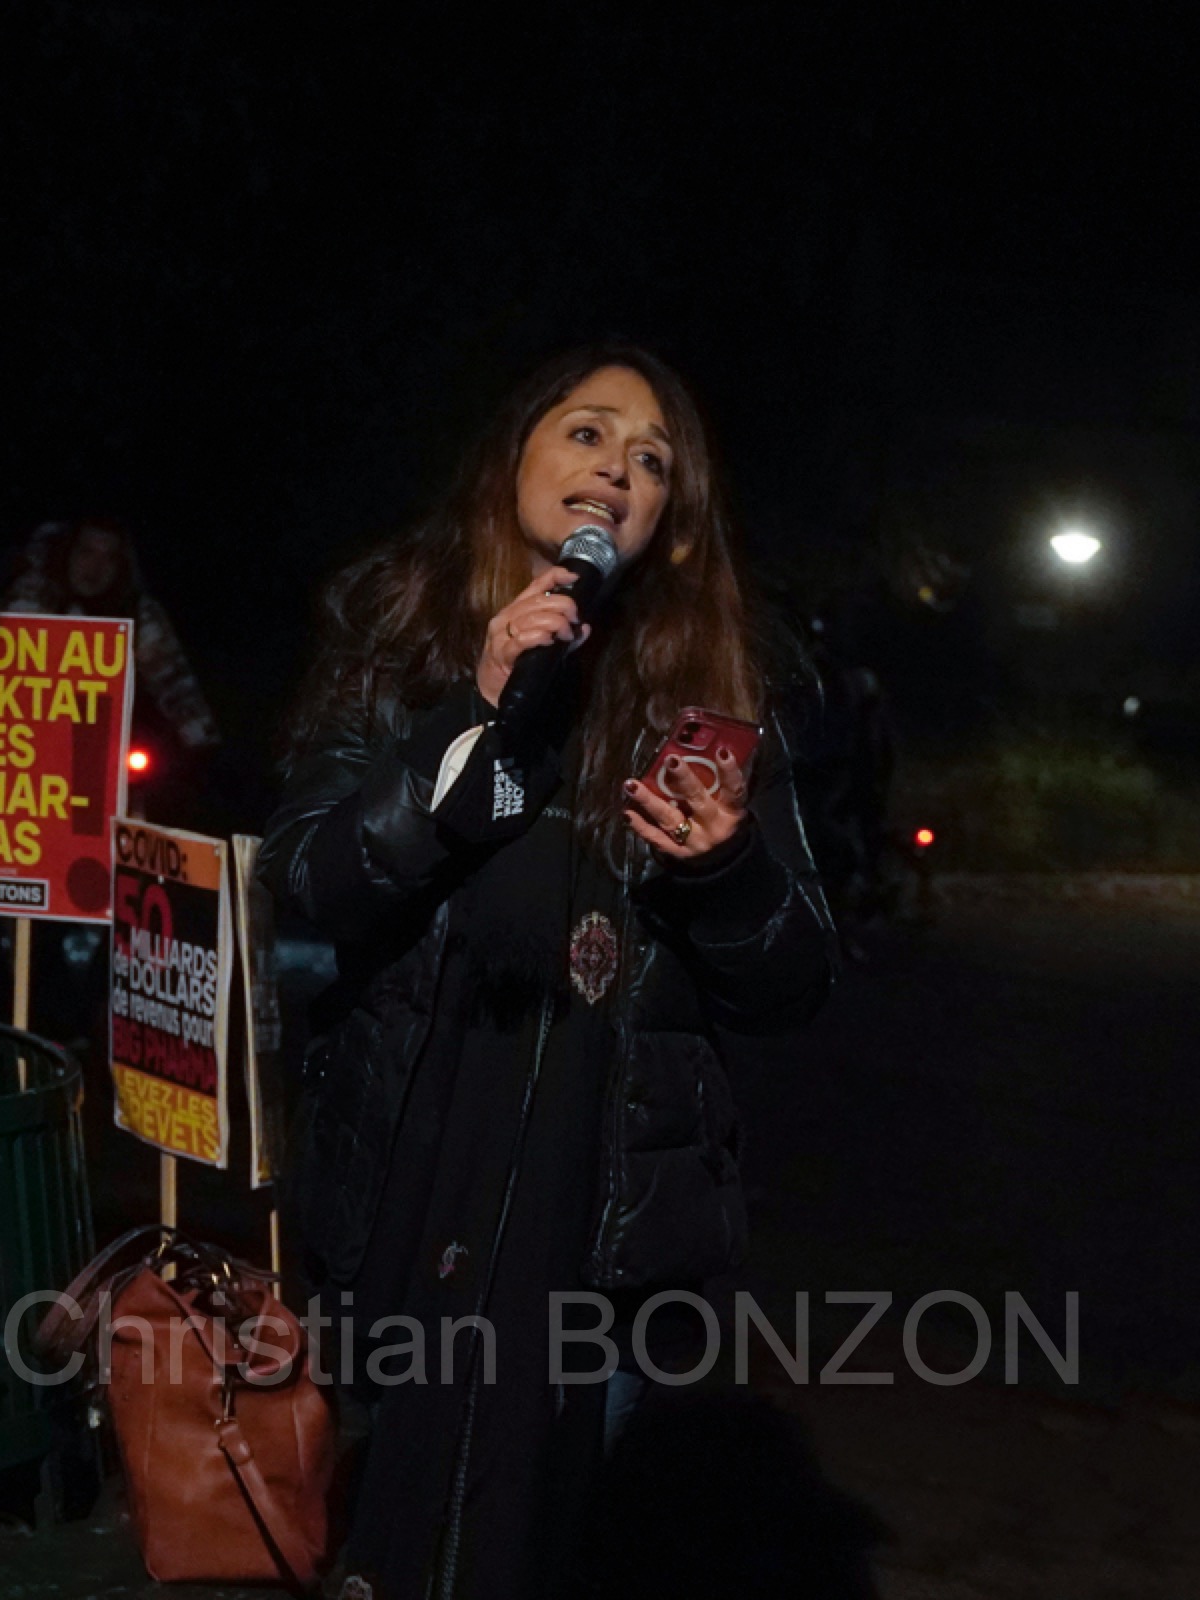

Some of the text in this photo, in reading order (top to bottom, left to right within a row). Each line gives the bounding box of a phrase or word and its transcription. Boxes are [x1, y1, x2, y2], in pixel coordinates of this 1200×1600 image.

[58, 631, 125, 677] AU
[117, 825, 188, 882] COVID:
[129, 957, 216, 1017] DOLLARS
